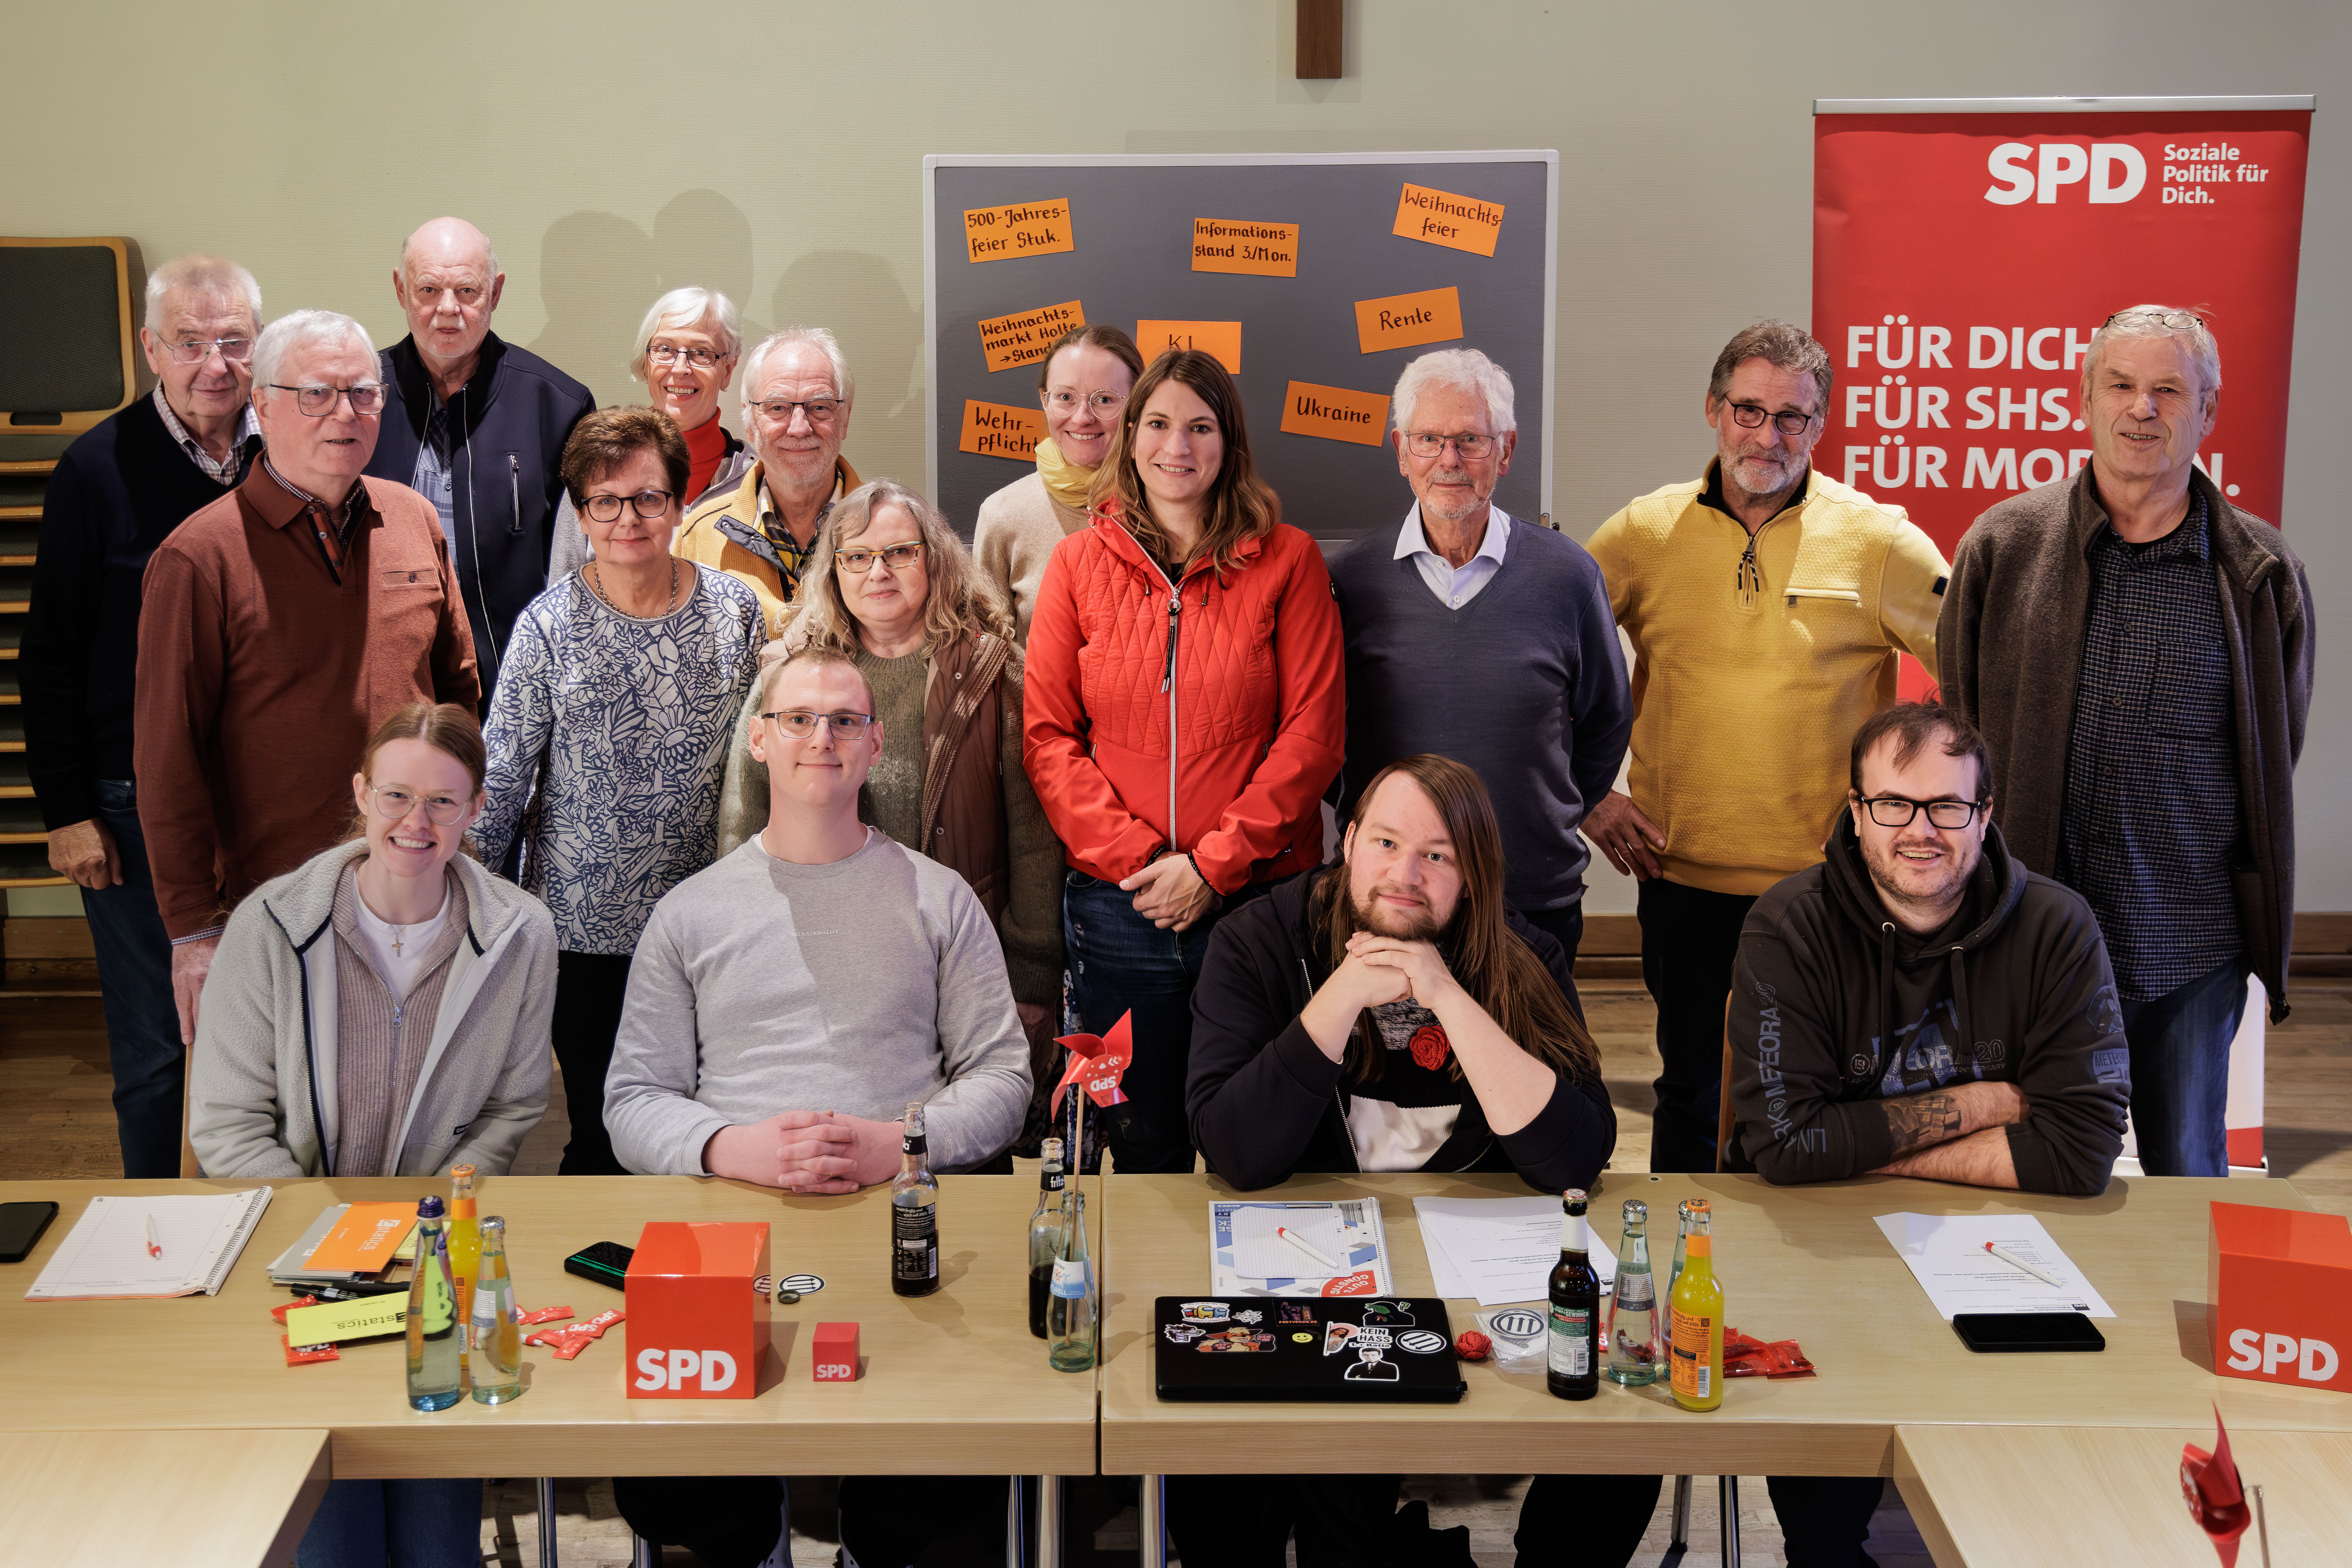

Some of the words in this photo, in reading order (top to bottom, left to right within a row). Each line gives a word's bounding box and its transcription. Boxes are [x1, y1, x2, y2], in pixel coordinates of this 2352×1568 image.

[2164, 143, 2240, 161] Soziale
[1984, 142, 2147, 205] SPD
[2163, 165, 2230, 182] Politik
[2236, 165, 2269, 182] für
[2161, 187, 2215, 204] Dich.
[967, 208, 1067, 228] 500-Jahres-
[1405, 189, 1502, 226] Weihnachts-
[1196, 221, 1292, 240] Informations-
[1421, 218, 1460, 238] feier
[972, 238, 1008, 258] feier
[1017, 229, 1060, 248] Stuk.
[1195, 244, 1234, 258] stand
[981, 309, 1075, 337] Weihnachts-
[1379, 307, 1434, 330] Rente
[986, 331, 1033, 351] markt
[1039, 323, 1076, 339] Holte
[1847, 315, 1953, 369] FÜR
[1012, 342, 1051, 362] Stand
[1297, 396, 1371, 424] Ukraine
[1845, 375, 1951, 429] FÜR
[1965, 387, 2087, 431] SHS.
[976, 407, 1034, 431] Wehr-
[978, 432, 1040, 454] pflicht
[1843, 435, 1949, 488] FÜR
[1974, 1039, 2005, 1064] 20
[1090, 1076, 1116, 1092] SPD
[363, 1219, 401, 1251] Estatics
[1330, 1274, 1368, 1294] GÜNSTIG
[336, 1312, 407, 1330] Estatics
[568, 1323, 598, 1332] SPD
[592, 1310, 618, 1324] SPD
[2226, 1328, 2339, 1382] SPD
[635, 1348, 737, 1391] SPD
[816, 1364, 851, 1378] SPD
